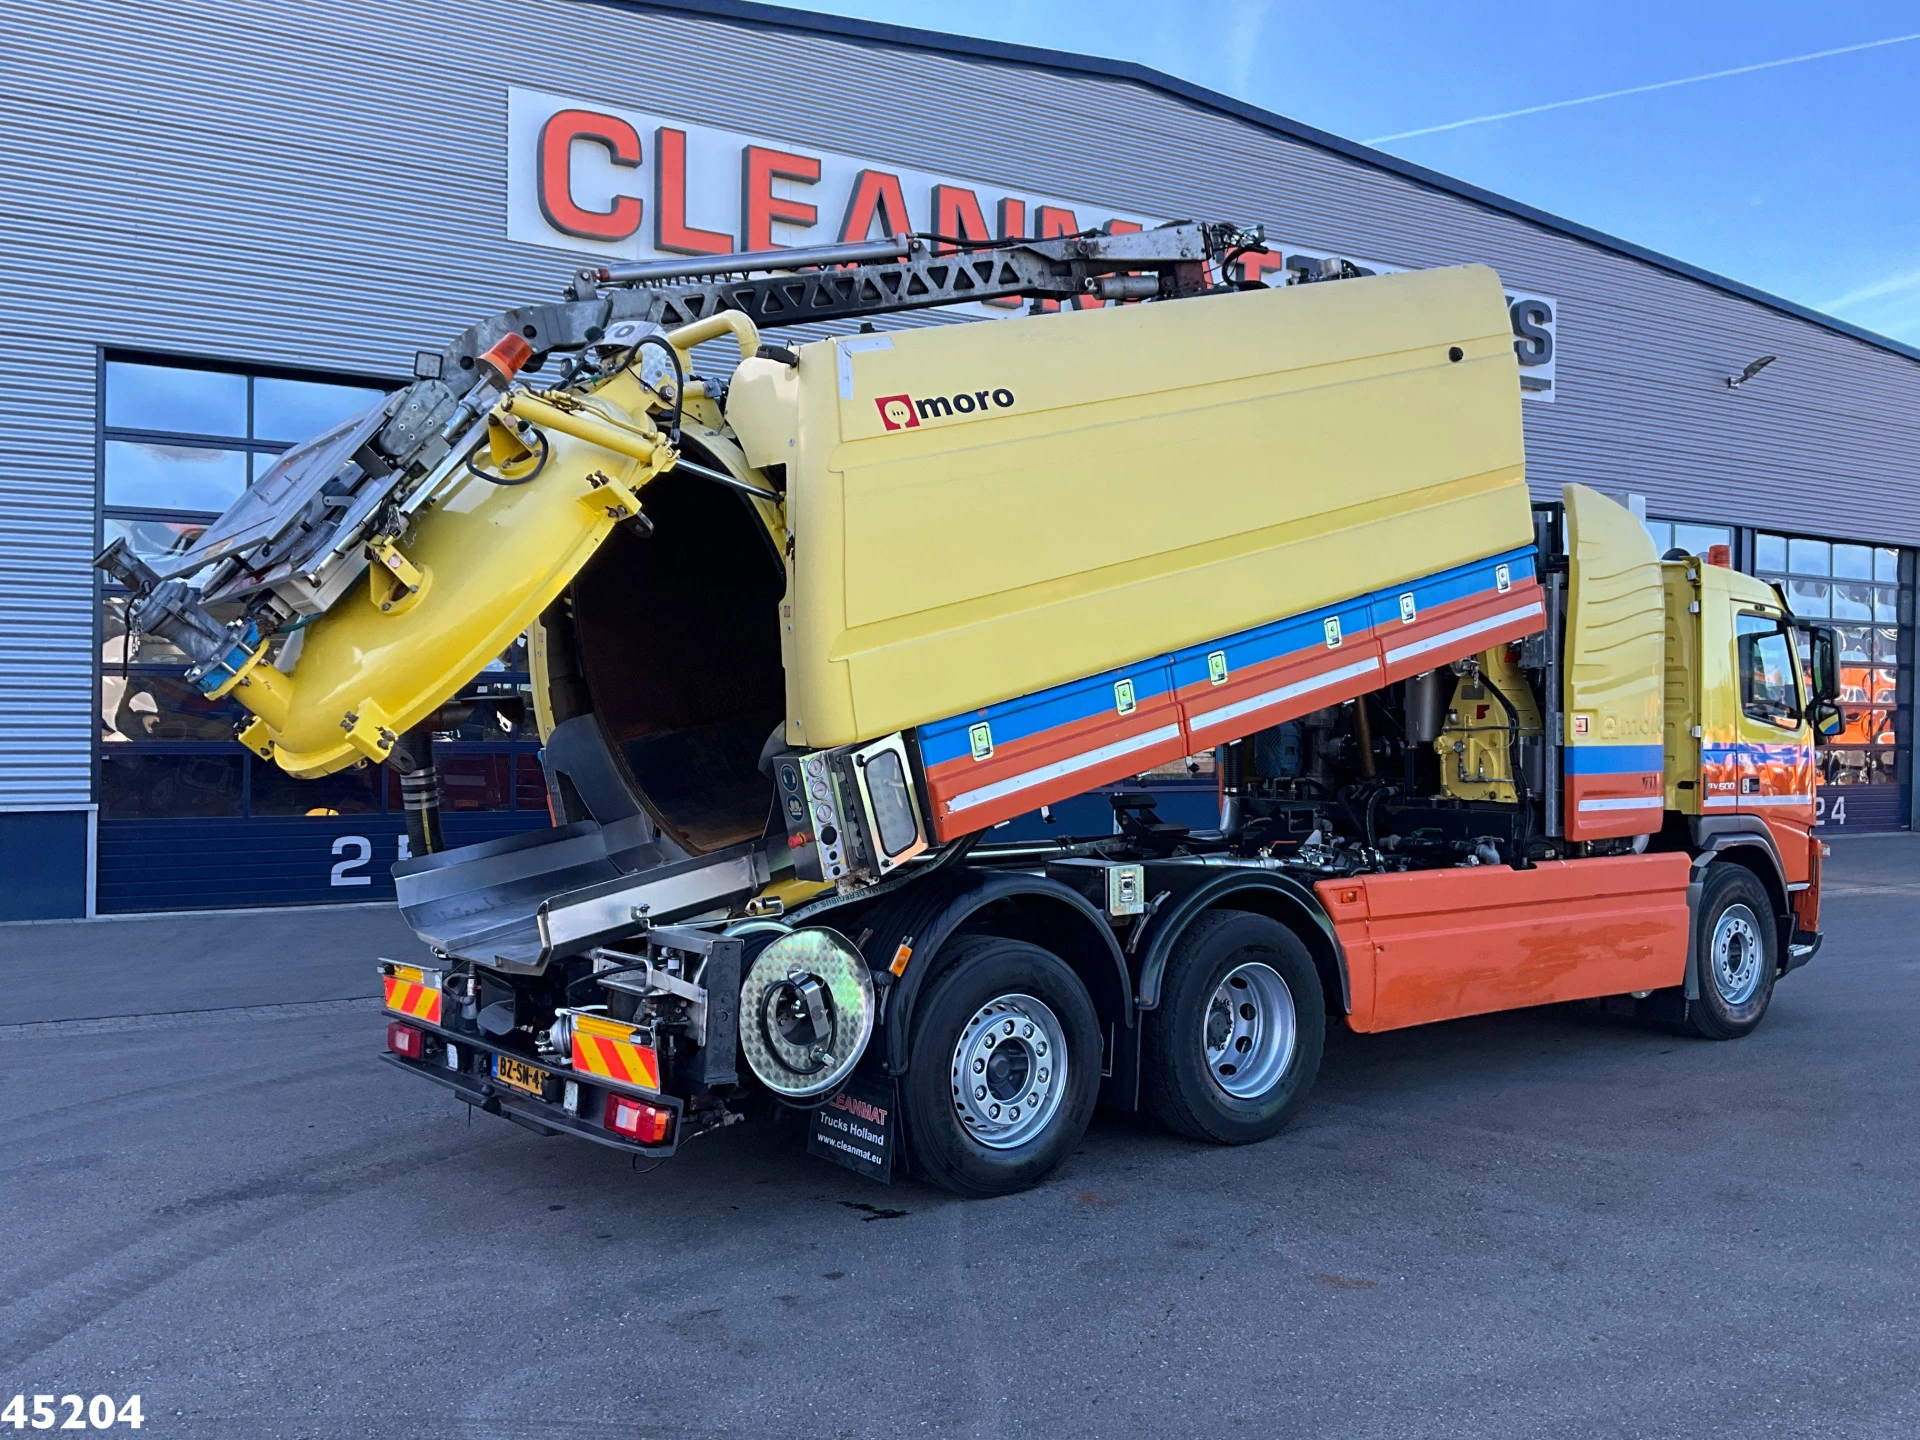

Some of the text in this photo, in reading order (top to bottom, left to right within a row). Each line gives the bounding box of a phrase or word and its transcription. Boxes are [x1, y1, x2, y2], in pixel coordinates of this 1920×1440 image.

[915, 387, 1015, 420] moro
[820, 1111, 884, 1146] Trucks Holland
[817, 1132, 882, 1165] www.cleanmat.eu
